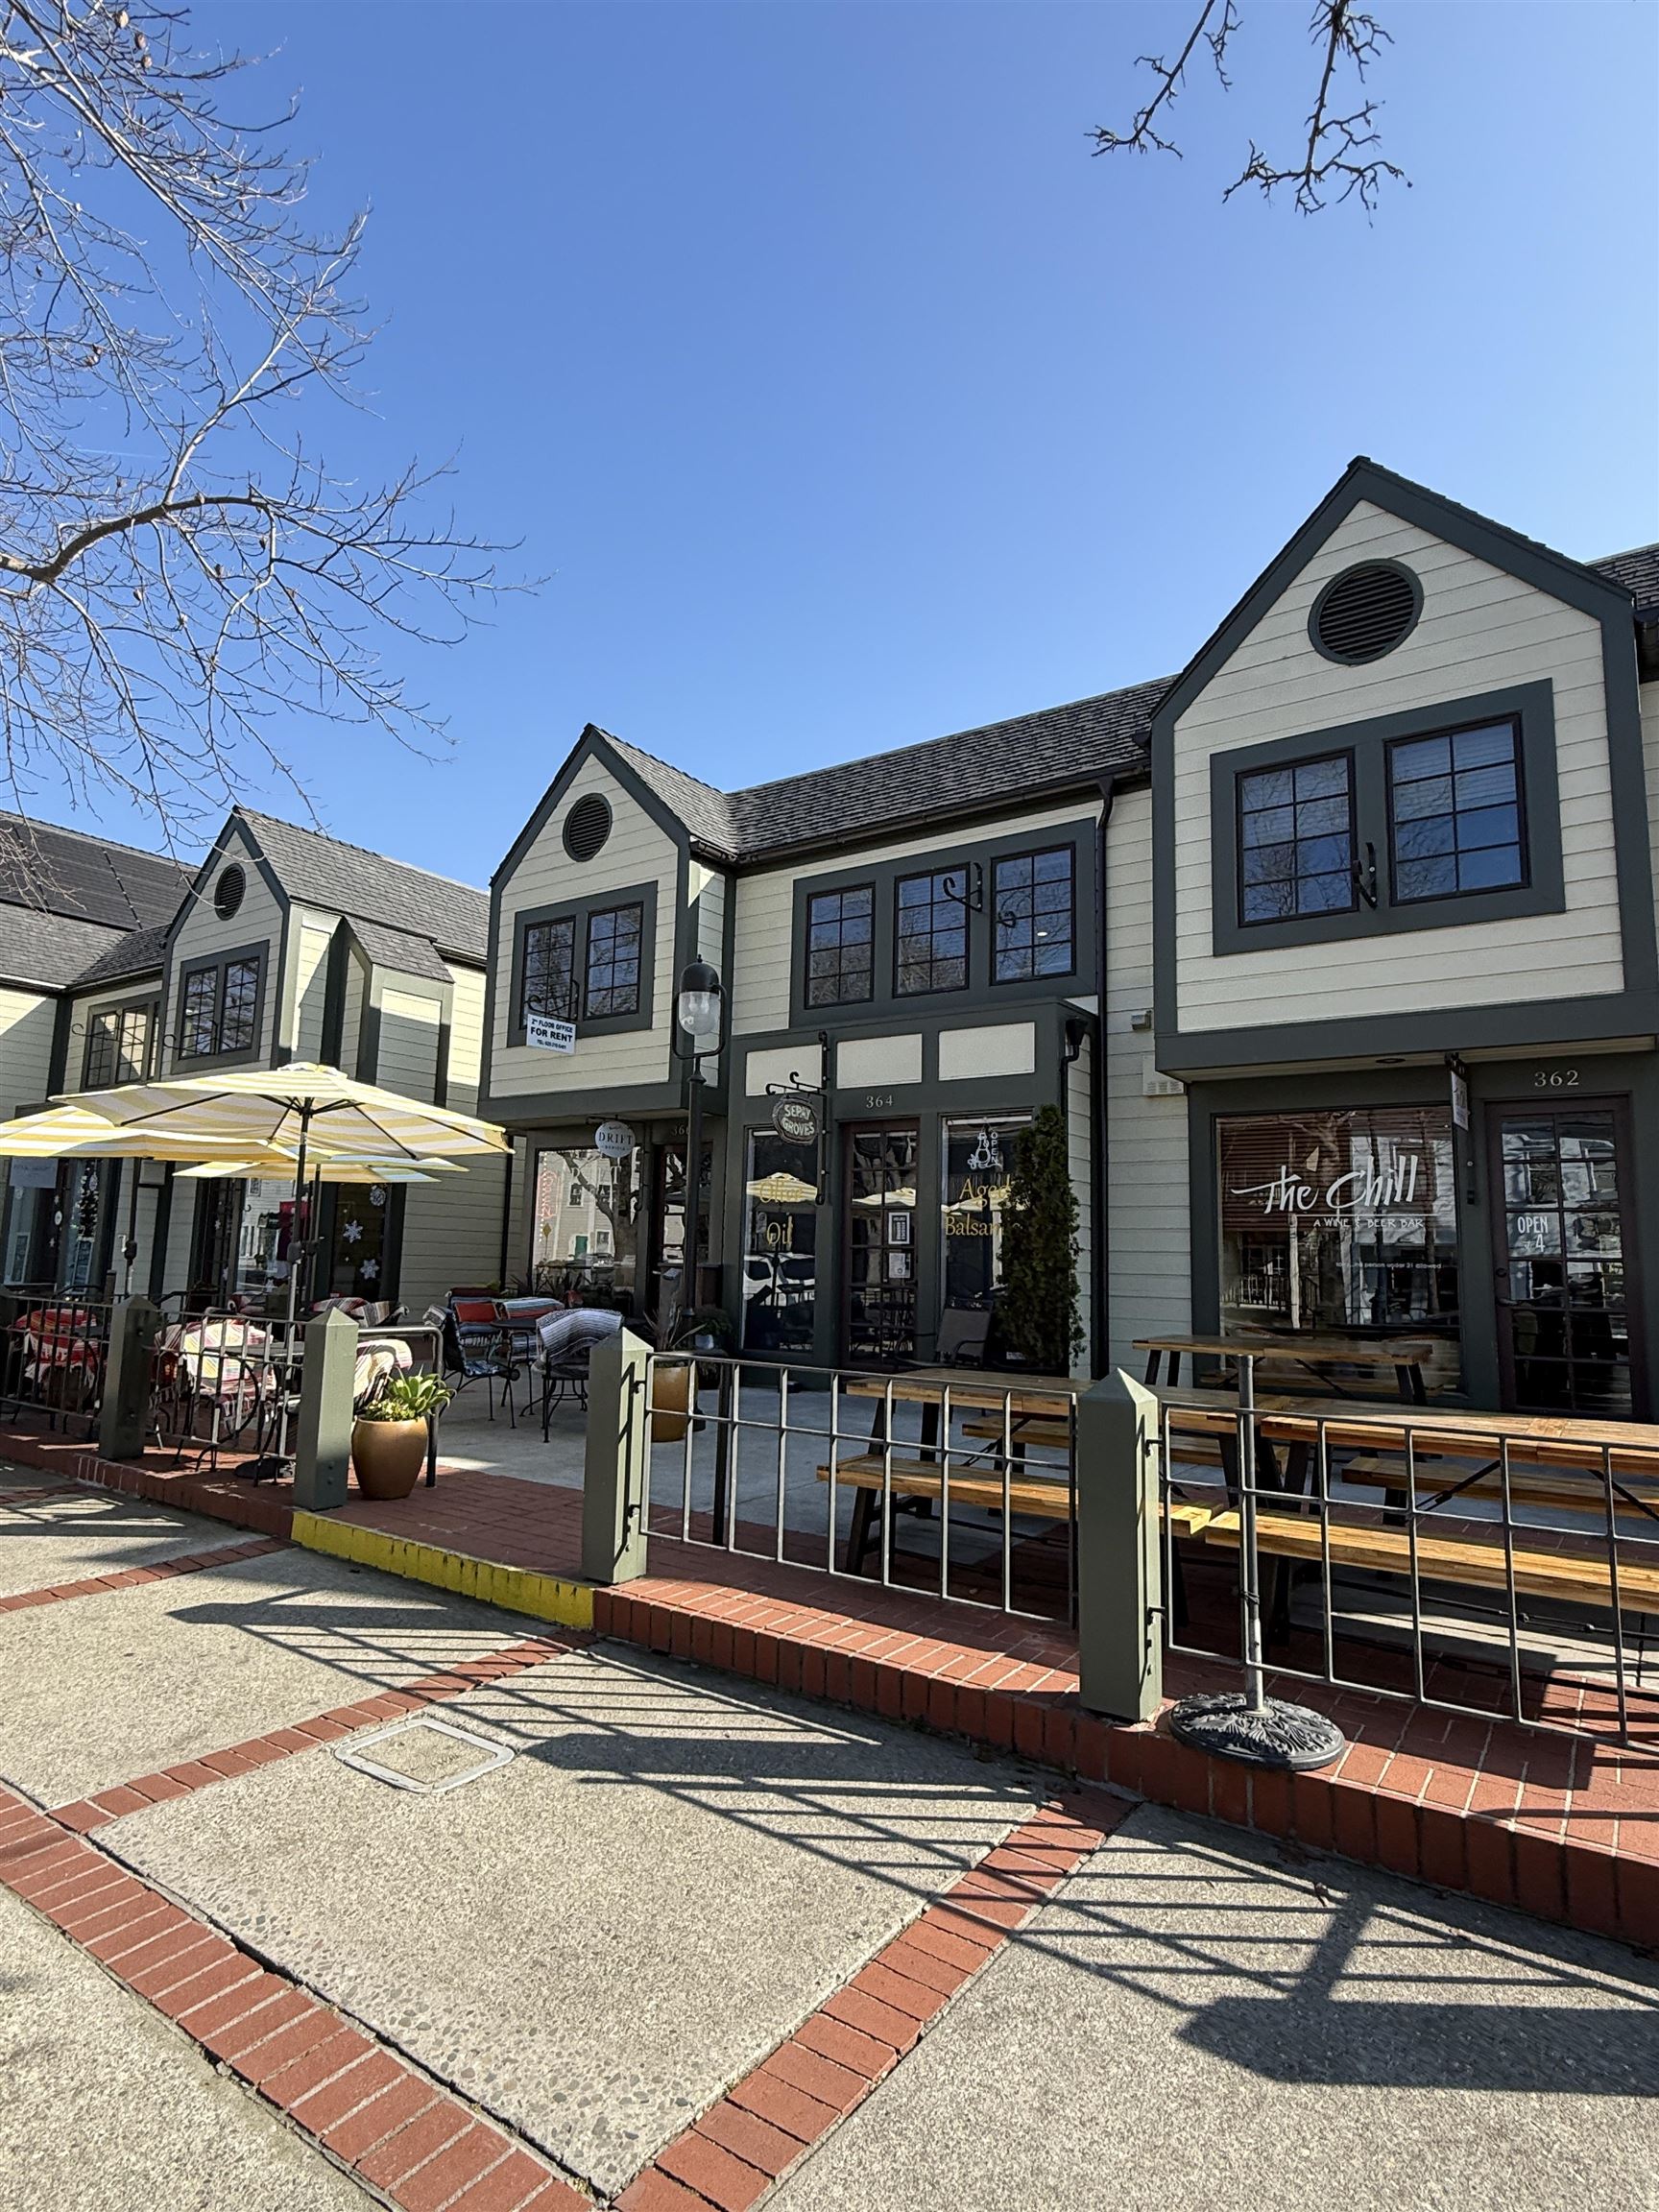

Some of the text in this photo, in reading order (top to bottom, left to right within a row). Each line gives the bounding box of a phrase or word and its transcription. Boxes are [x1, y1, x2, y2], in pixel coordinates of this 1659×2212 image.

[531, 1026, 573, 1043] FOR RENT
[539, 1020, 555, 1029] FLOOR
[556, 1023, 573, 1033] OFFICE
[1534, 1070, 1579, 1087] 362
[866, 1095, 893, 1108] 364
[781, 1117, 815, 1136] GROVES
[598, 1132, 633, 1144] DRIFT
[991, 1132, 999, 1163] OPEN
[760, 1178, 804, 1203] Olive
[959, 1174, 1012, 1208] Aged
[1231, 1155, 1418, 1214] The Chill
[767, 1214, 793, 1245] Oil
[1324, 1217, 1350, 1227] WINE
[1366, 1218, 1396, 1228] BEER
[1400, 1218, 1424, 1228] BAR
[1518, 1215, 1549, 1234] OPEN
[1536, 1234, 1546, 1253] 4
